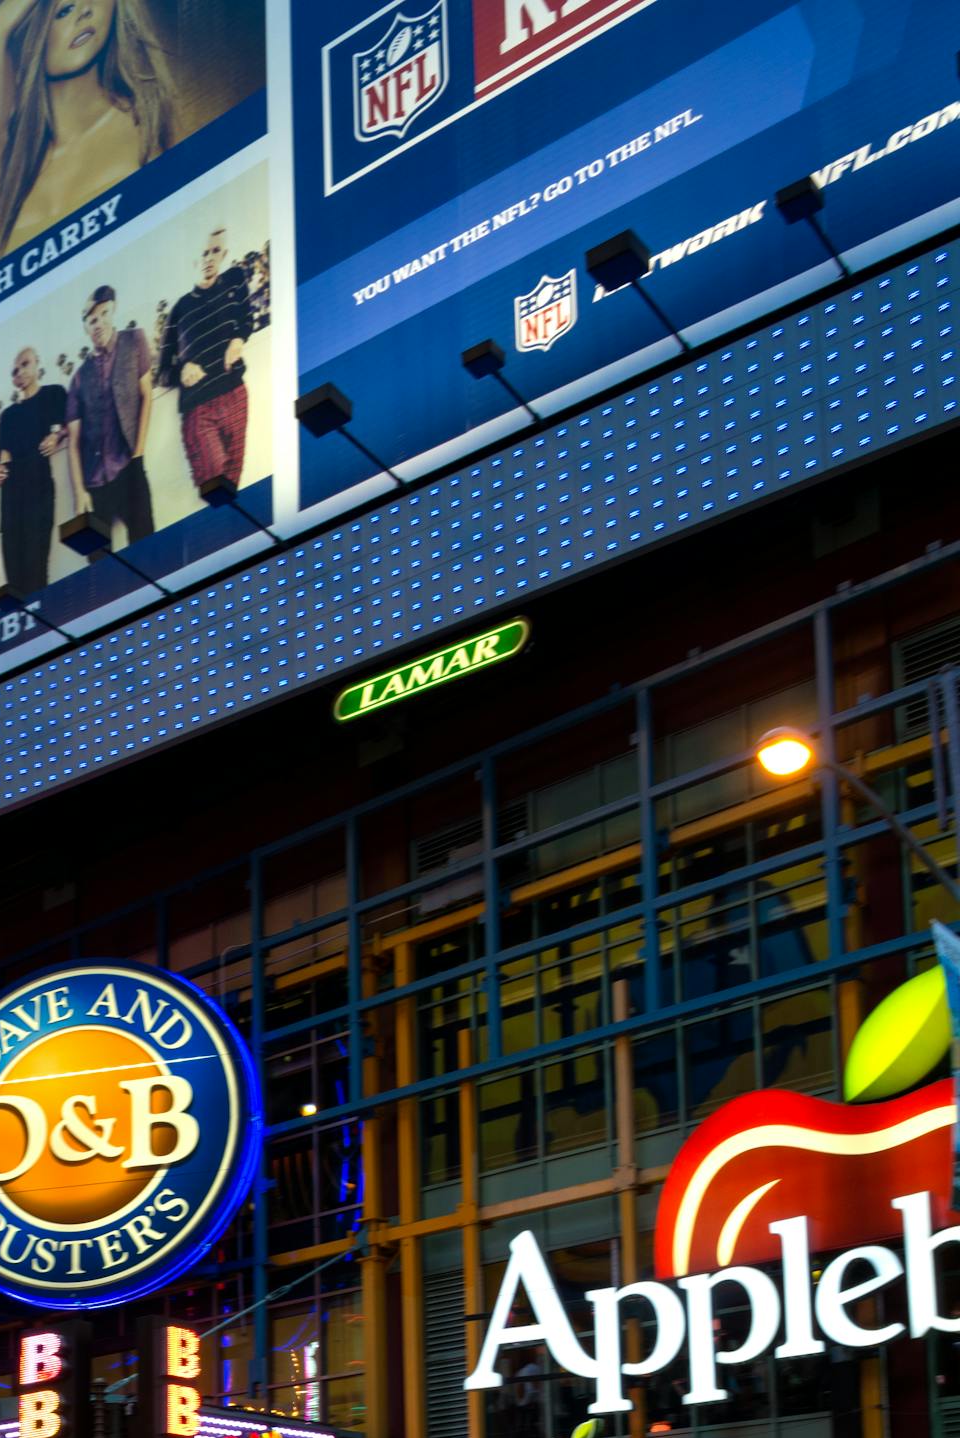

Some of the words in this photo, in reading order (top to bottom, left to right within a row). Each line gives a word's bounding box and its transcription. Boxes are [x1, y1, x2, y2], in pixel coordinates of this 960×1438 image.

[366, 52, 436, 128] NFL
[20, 193, 123, 278] CAREY
[352, 274, 390, 306] YOU
[392, 243, 448, 284] WANT
[449, 219, 490, 253] THE
[492, 192, 541, 231] NFL?
[543, 175, 573, 202] GO
[574, 158, 605, 185] TO
[605, 131, 652, 168] THE
[592, 199, 768, 304] TWORK
[525, 302, 568, 342] NFL
[359, 634, 501, 709] LAMAR
[85, 982, 193, 1051] AND
